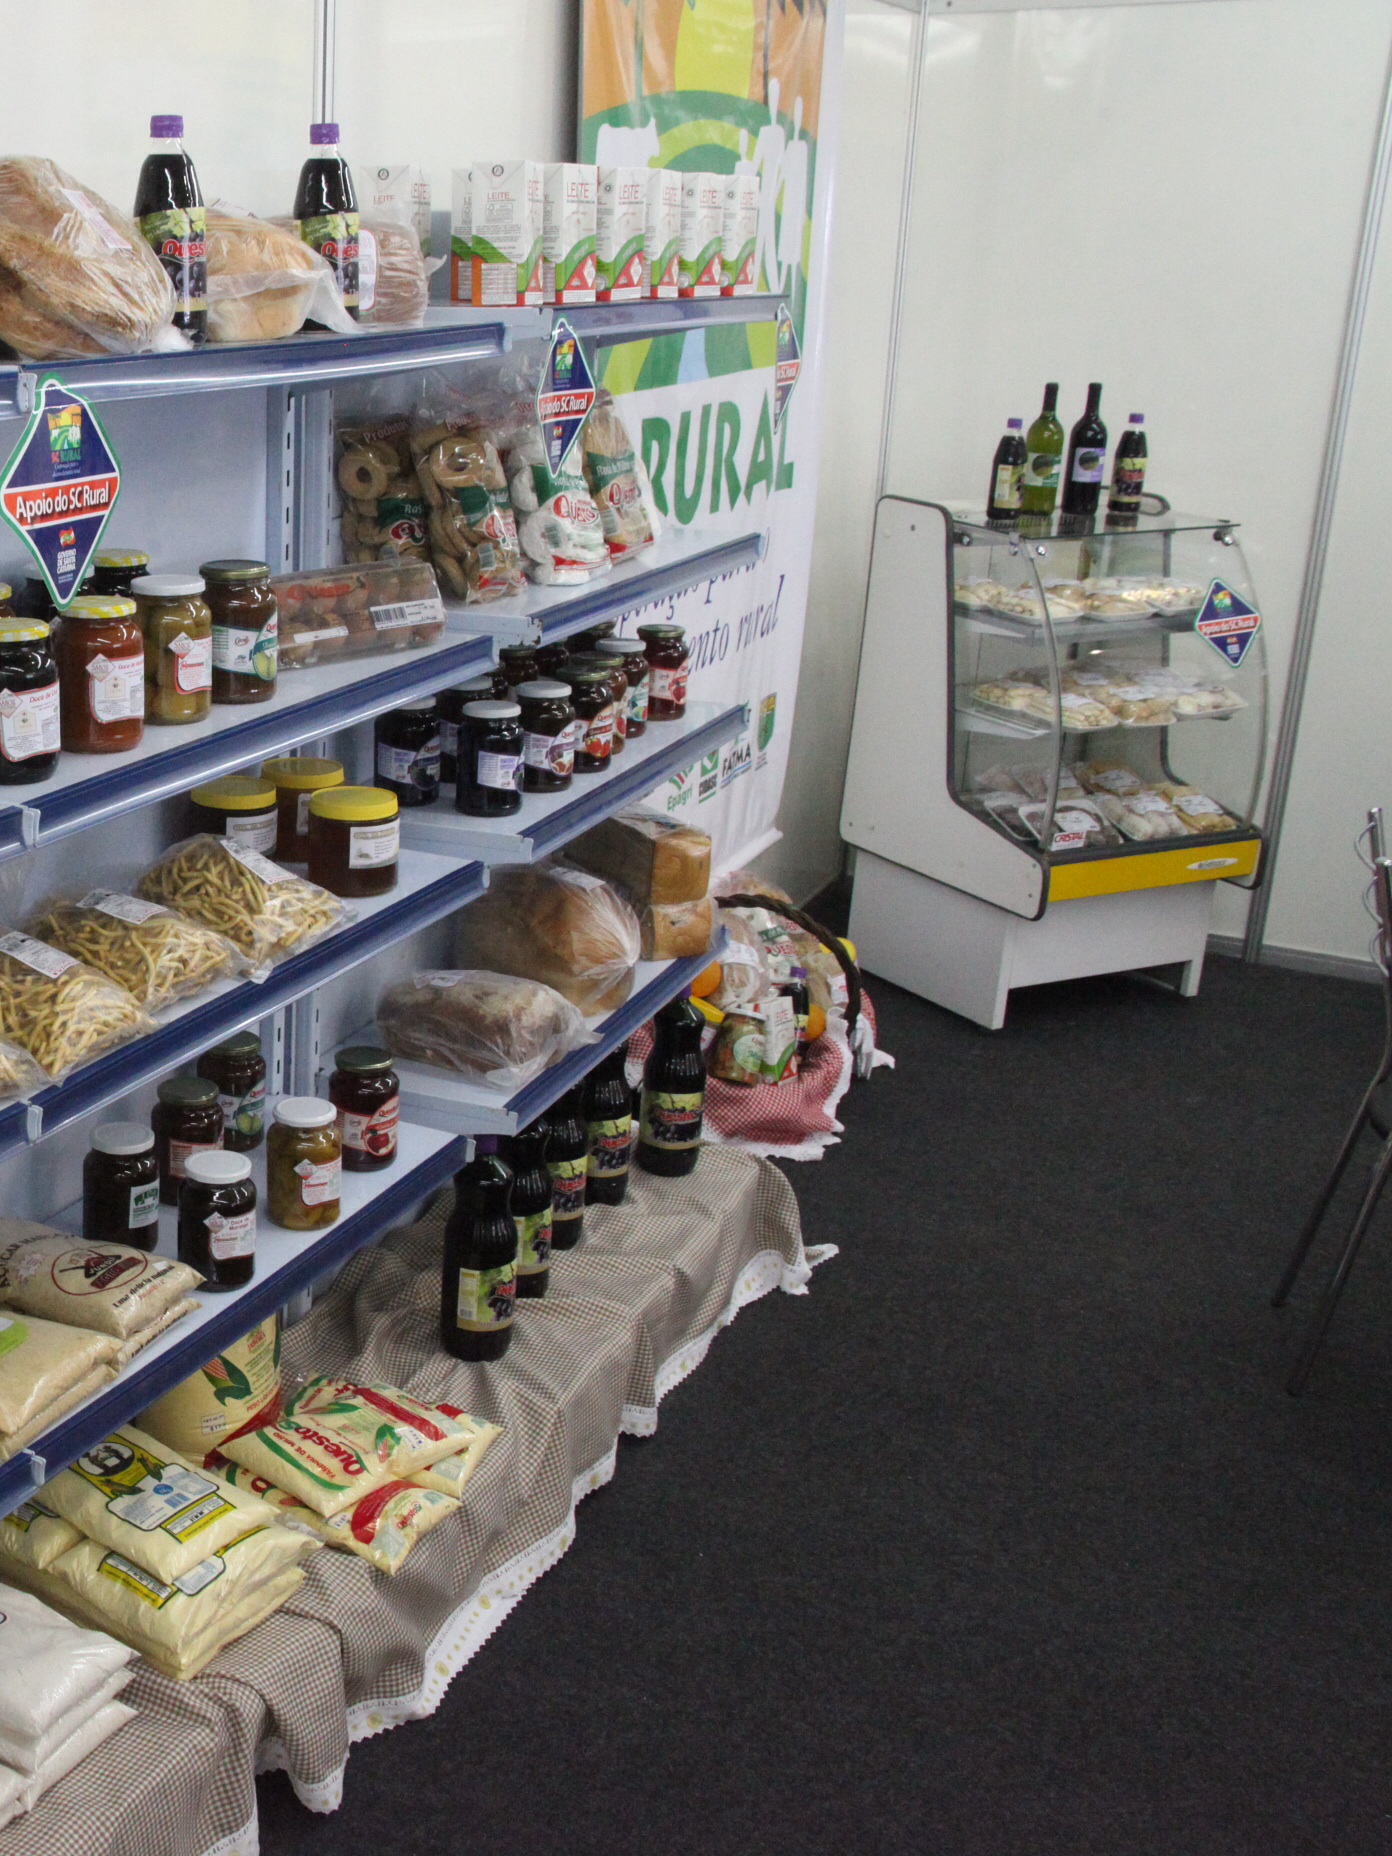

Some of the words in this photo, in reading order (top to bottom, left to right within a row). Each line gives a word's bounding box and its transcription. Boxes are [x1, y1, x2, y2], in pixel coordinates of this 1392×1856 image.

[567, 183, 589, 199] LEITE
[561, 396, 569, 411] SC
[570, 393, 588, 411] Rural
[641, 387, 795, 526] RURAL
[16, 489, 52, 523] Apoio
[54, 493, 68, 513] do
[70, 486, 83, 508] SC
[83, 481, 109, 505] Rural
[736, 573, 786, 653] rural
[667, 783, 693, 812] Epagri
[272, 1431, 296, 1447] MILHO
[293, 1445, 306, 1457] DE
[305, 1454, 337, 1480] FARINHA
